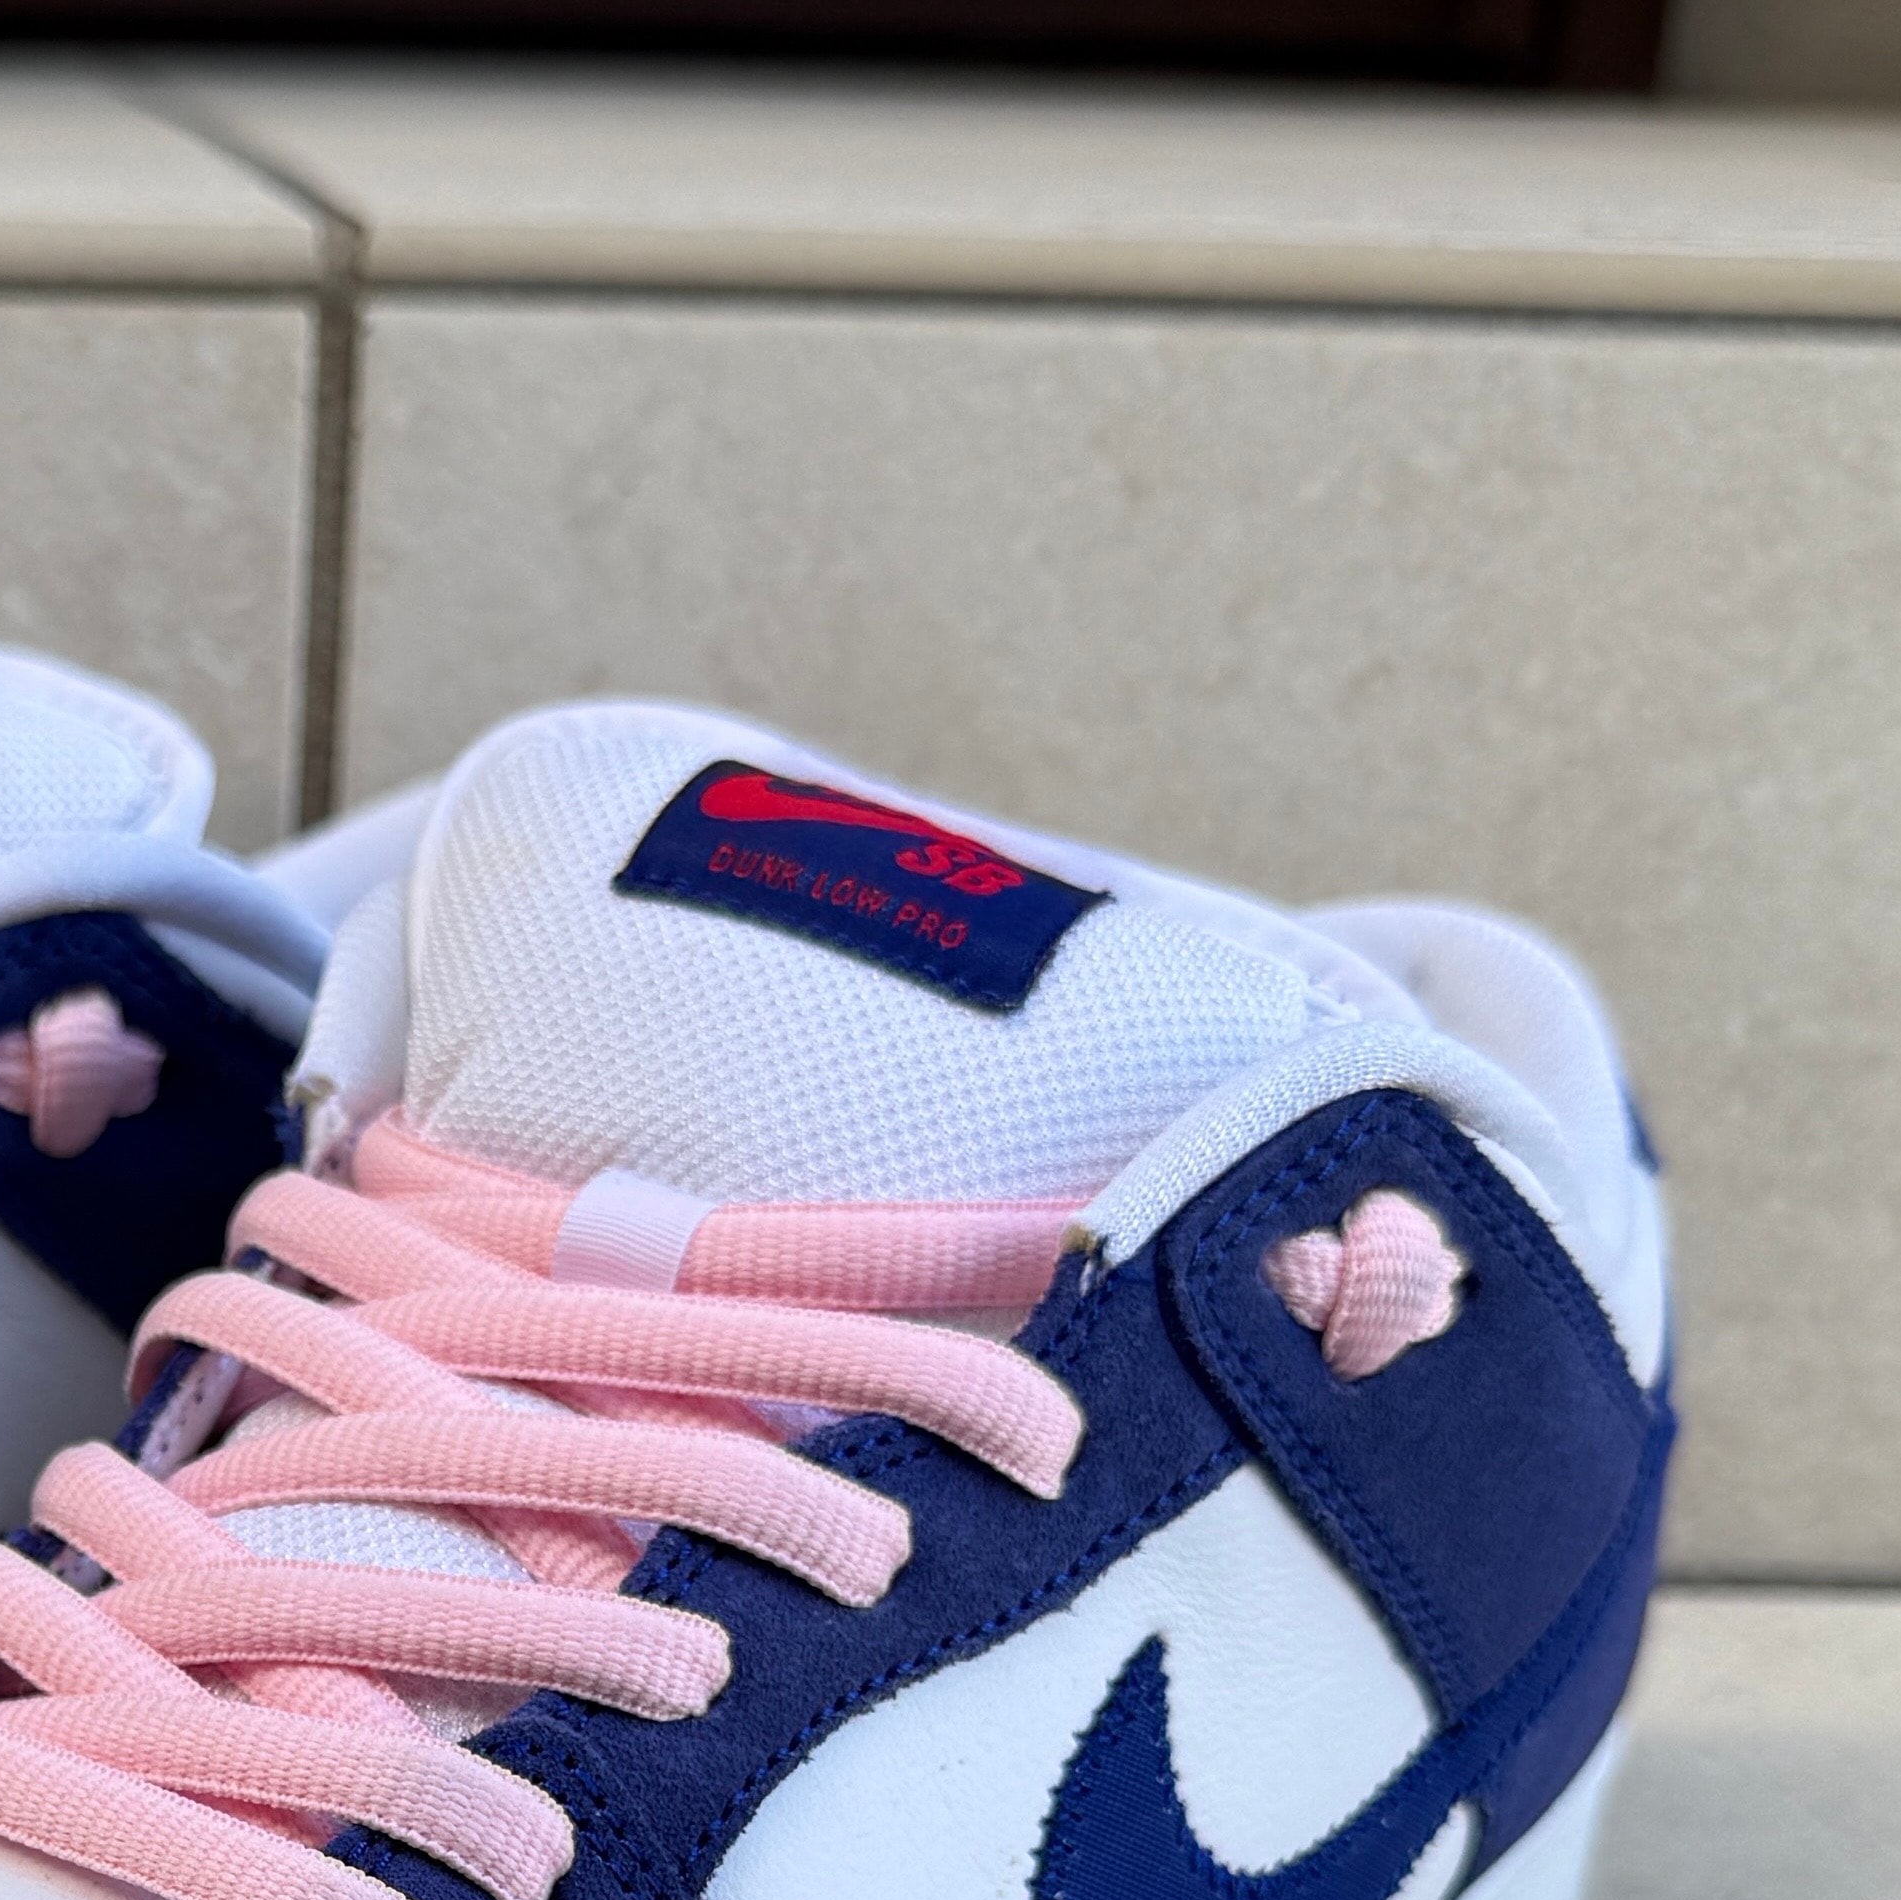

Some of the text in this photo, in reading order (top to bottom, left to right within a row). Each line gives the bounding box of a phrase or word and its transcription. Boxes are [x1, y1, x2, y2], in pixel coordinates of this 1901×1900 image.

[709, 845, 968, 949] DUNK LOW PRO
[896, 843, 1024, 895] SB
